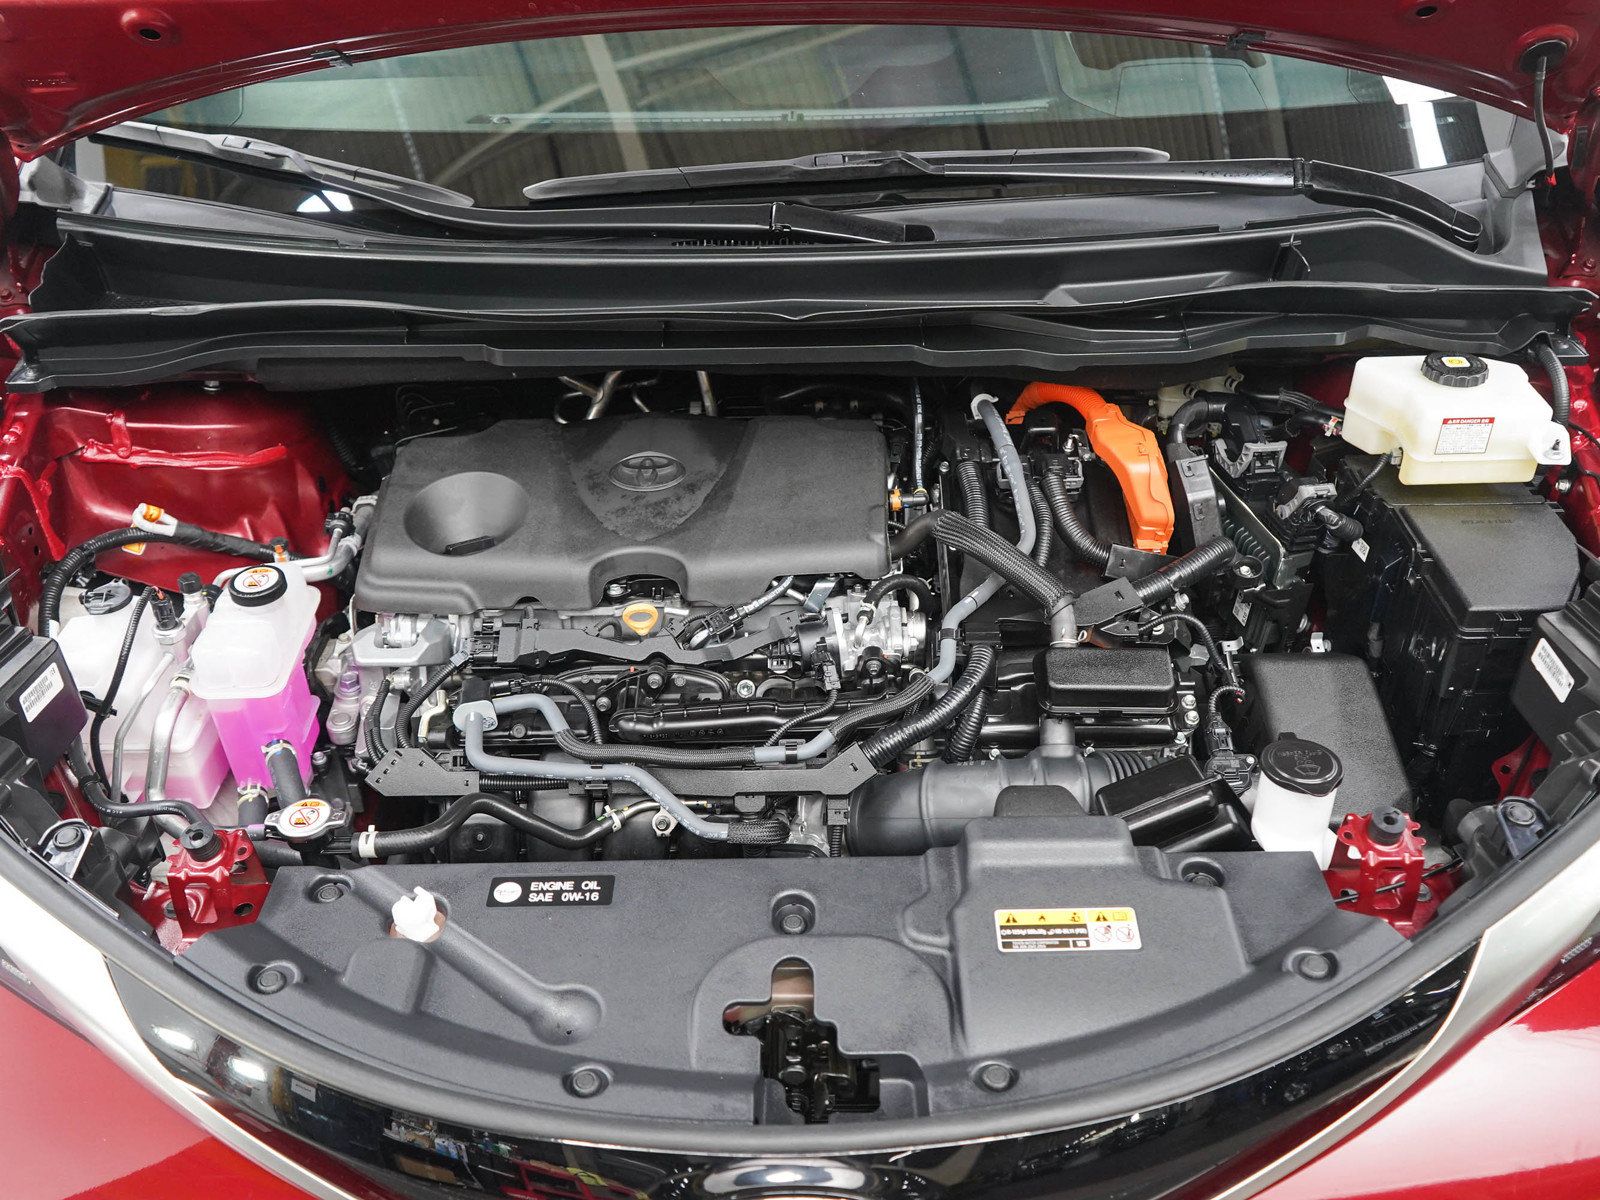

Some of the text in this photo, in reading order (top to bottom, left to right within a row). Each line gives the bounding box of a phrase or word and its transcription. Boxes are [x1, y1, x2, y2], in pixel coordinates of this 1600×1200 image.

[530, 880, 602, 891] ENGINE OIL
[528, 892, 554, 902] SAE
[561, 892, 600, 902] 0W-16
